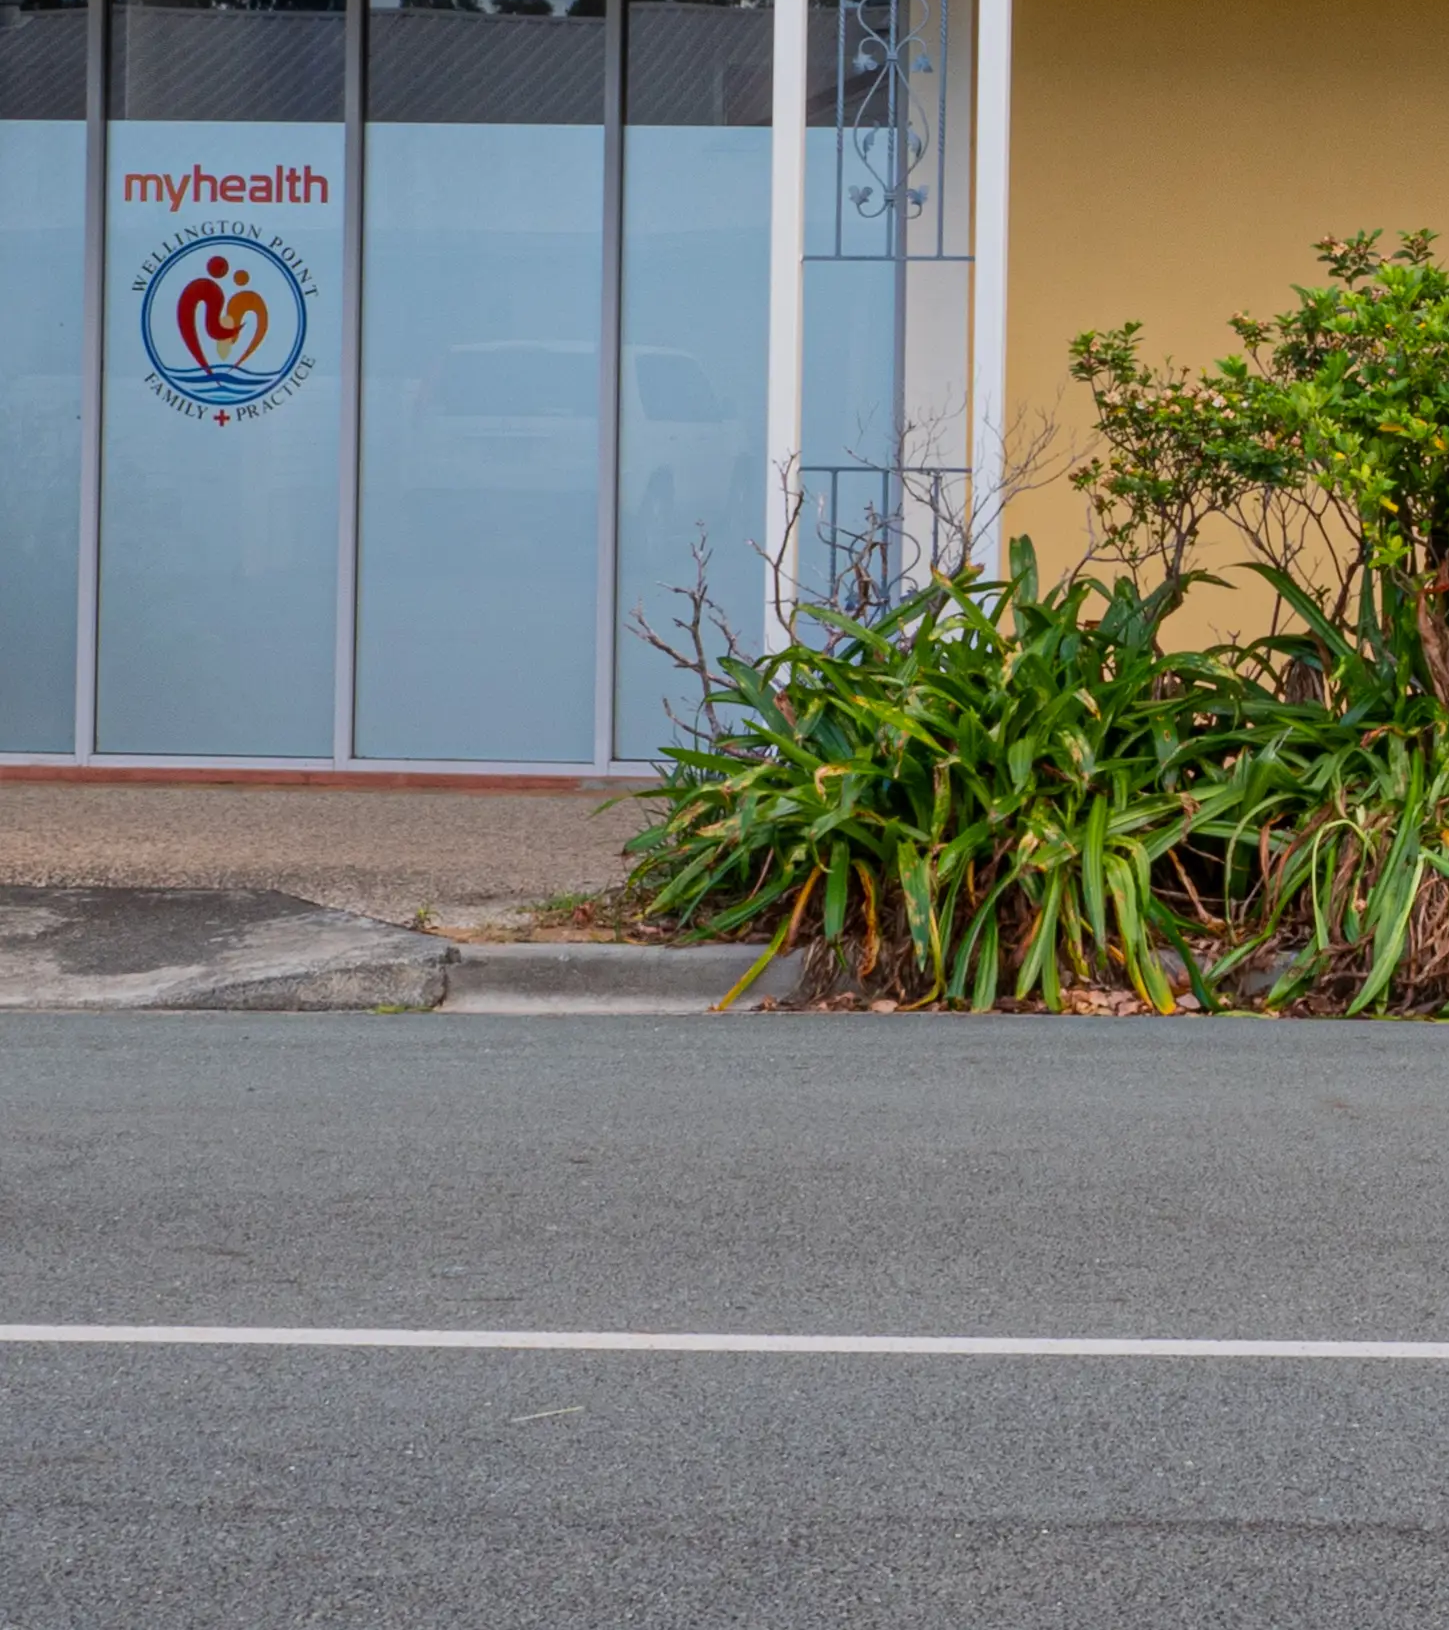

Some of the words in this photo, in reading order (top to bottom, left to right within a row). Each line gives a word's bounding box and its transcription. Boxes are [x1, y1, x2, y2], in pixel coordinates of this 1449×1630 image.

[124, 164, 328, 212] myhealth
[132, 220, 263, 293] WELLINGTON
[269, 236, 319, 298] POINT
[144, 372, 208, 420] FAMILY
[236, 355, 316, 422] PRACTICE
